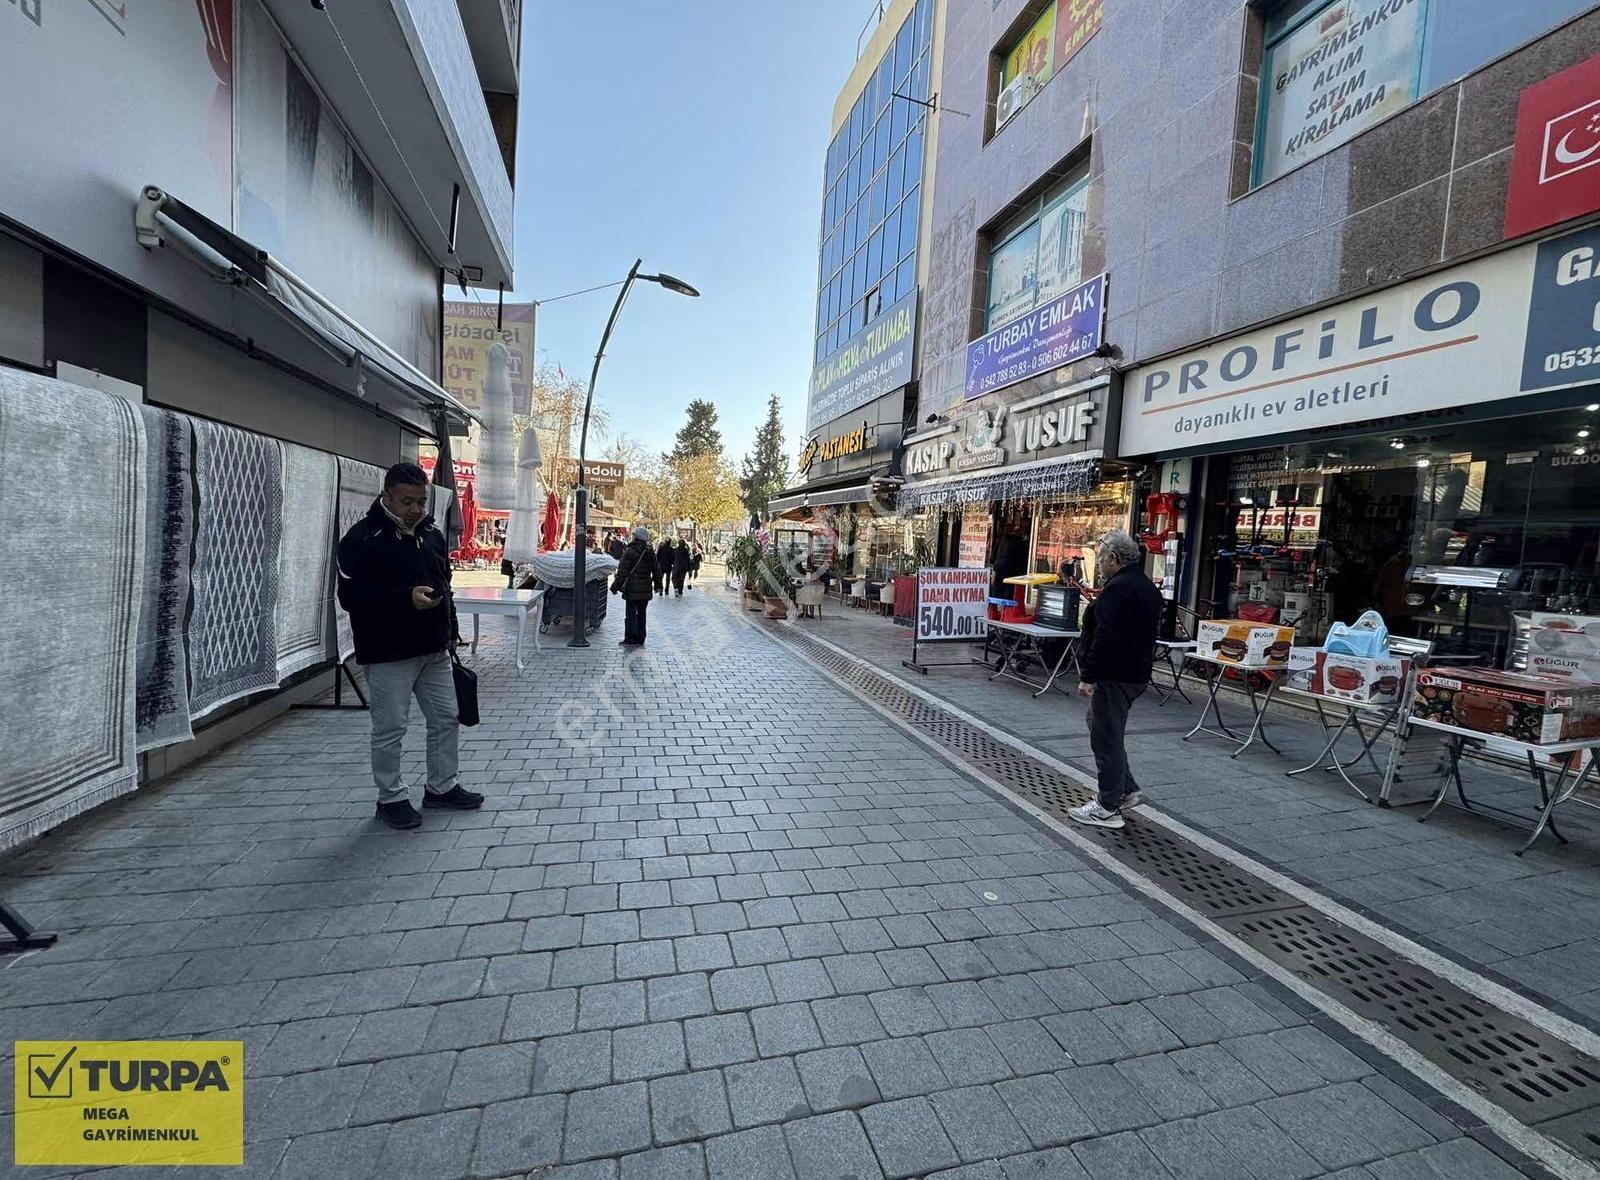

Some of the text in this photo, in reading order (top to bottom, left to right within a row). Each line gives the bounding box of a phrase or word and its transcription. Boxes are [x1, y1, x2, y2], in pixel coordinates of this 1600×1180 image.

[1276, 0, 1413, 91] GAYRİMENKU
[1313, 45, 1364, 91] ALIM
[1285, 84, 1385, 155] KİRALAMA
[1306, 69, 1366, 119] SATIM
[1556, 246, 1600, 286] G
[866, 307, 911, 360] TULUMBA
[987, 315, 1037, 355] TURBAY
[1039, 284, 1095, 331] EMLAK
[1174, 375, 1389, 435] dayanıklı ev aletleri
[906, 401, 1096, 475] KASAP YUSUF
[941, 571, 988, 585] KAMPANYA
[952, 588, 985, 603] KIYMA
